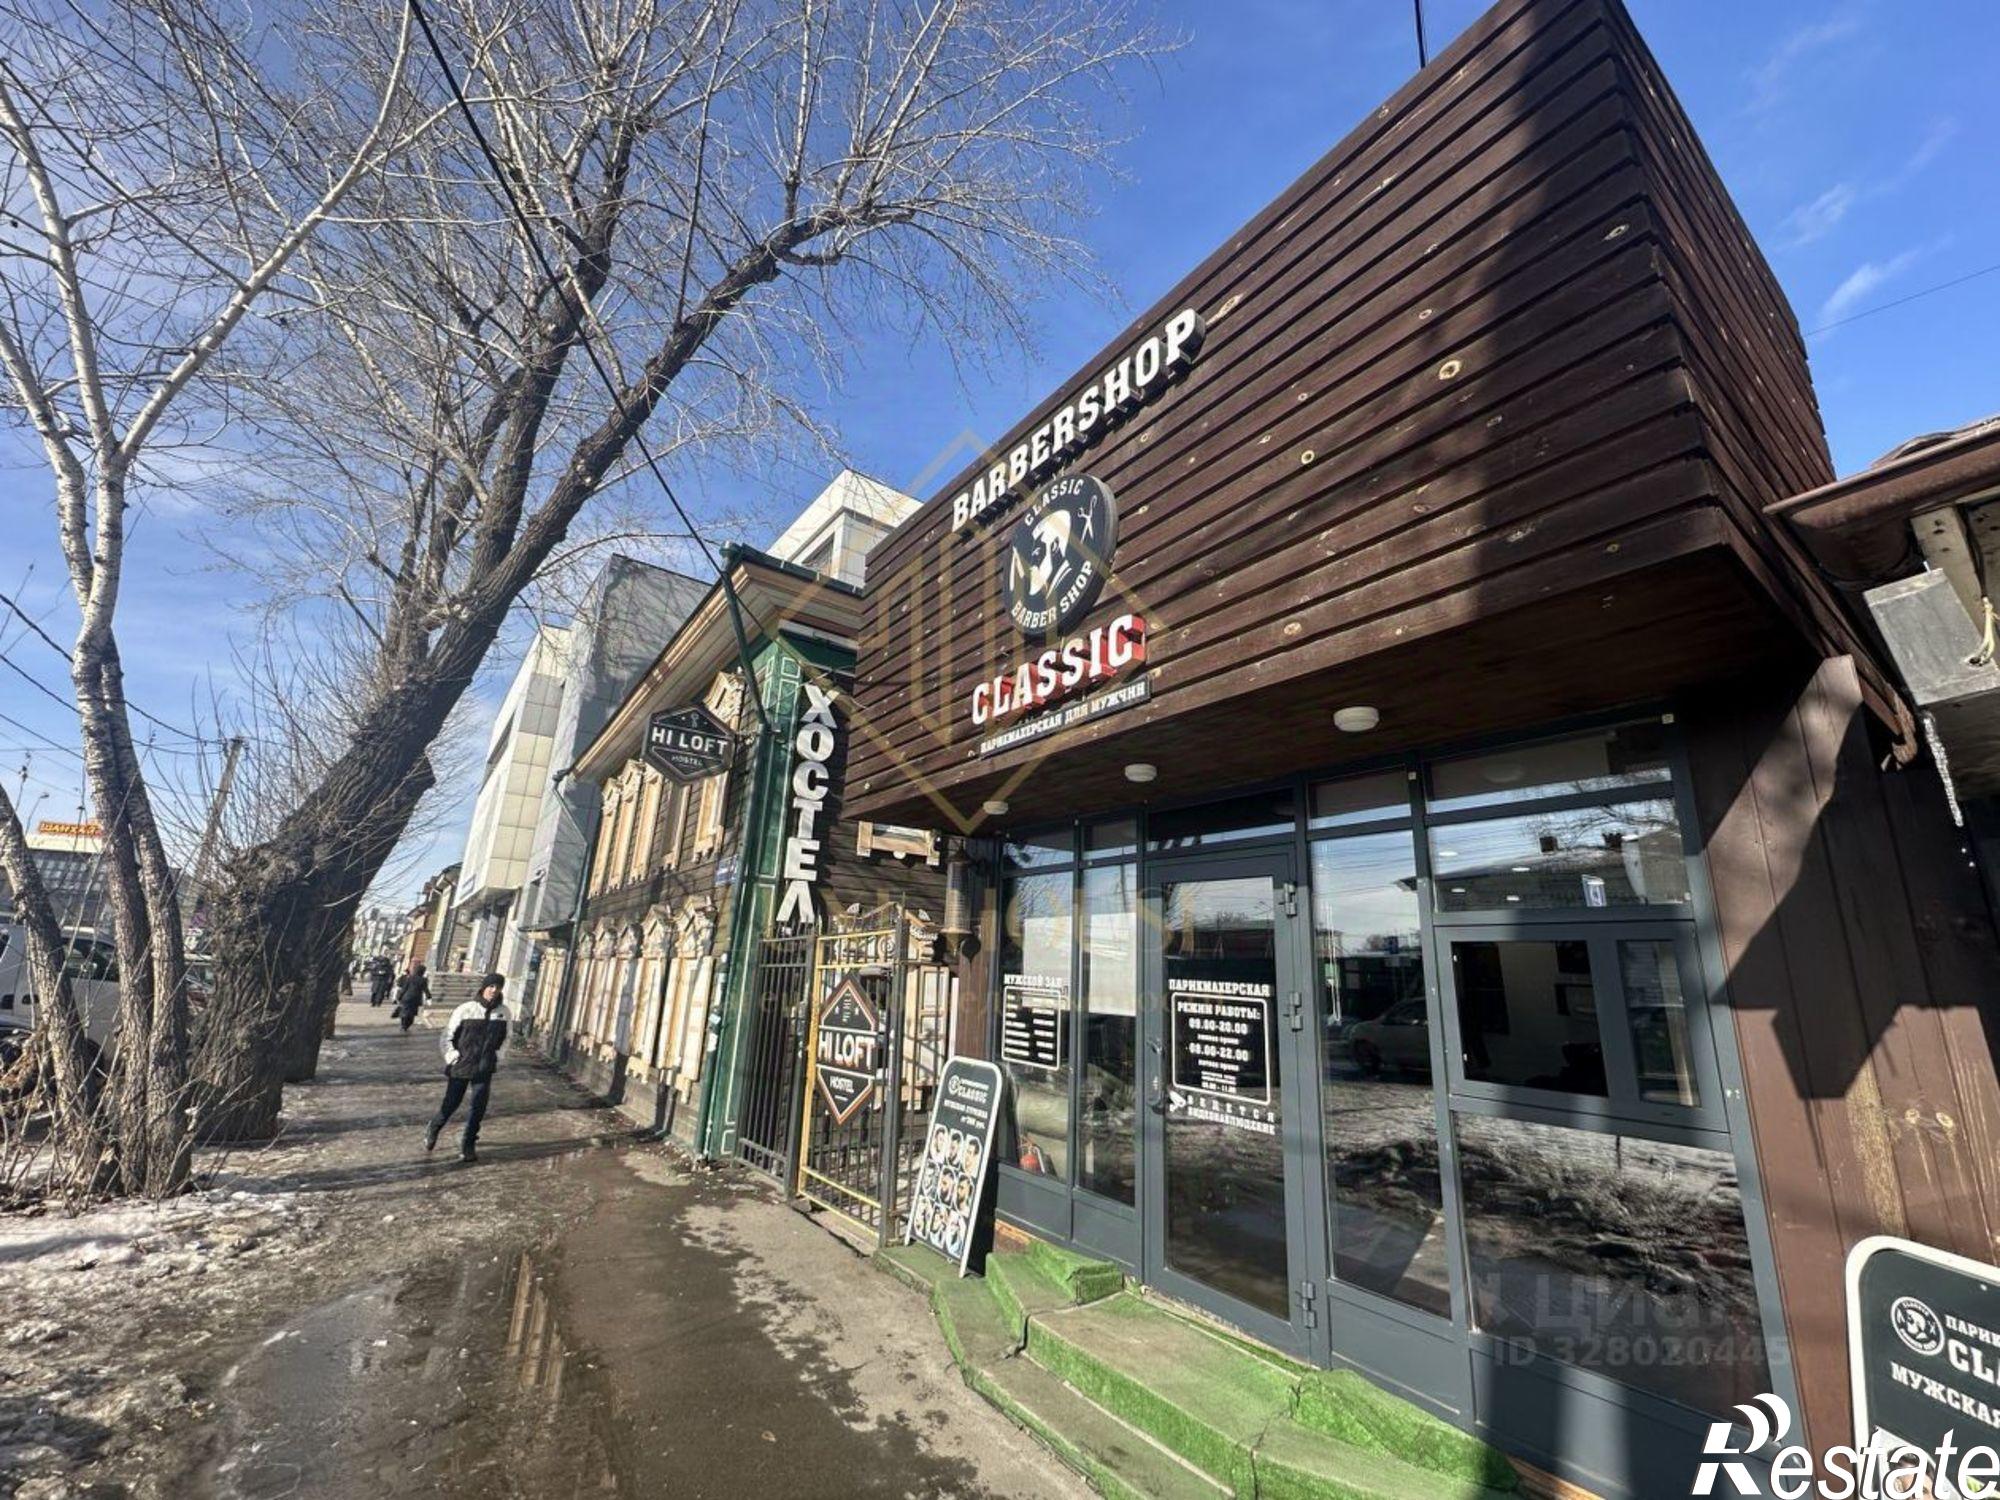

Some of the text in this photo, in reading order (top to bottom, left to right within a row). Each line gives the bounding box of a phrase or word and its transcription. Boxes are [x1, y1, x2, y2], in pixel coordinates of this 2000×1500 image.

[951, 308, 1198, 533] BARBERSHOP
[1024, 478, 1084, 527] CLASSIC
[1011, 560, 1092, 629] BARBER SHOP
[972, 614, 1136, 726] CLASSIC
[651, 726, 728, 755] HI LOFT
[980, 713, 1062, 754] ПАРИКМАХЕРСКАЯ
[1091, 681, 1146, 714] МУЖЧИН
[776, 683, 840, 923] ХОСТЕЛ
[1168, 979, 1271, 997] ПАРИКМАХЕРСКАЯ
[1177, 1001, 1213, 1015] РЕЖИМ
[817, 1030, 876, 1070] HI LOFT
